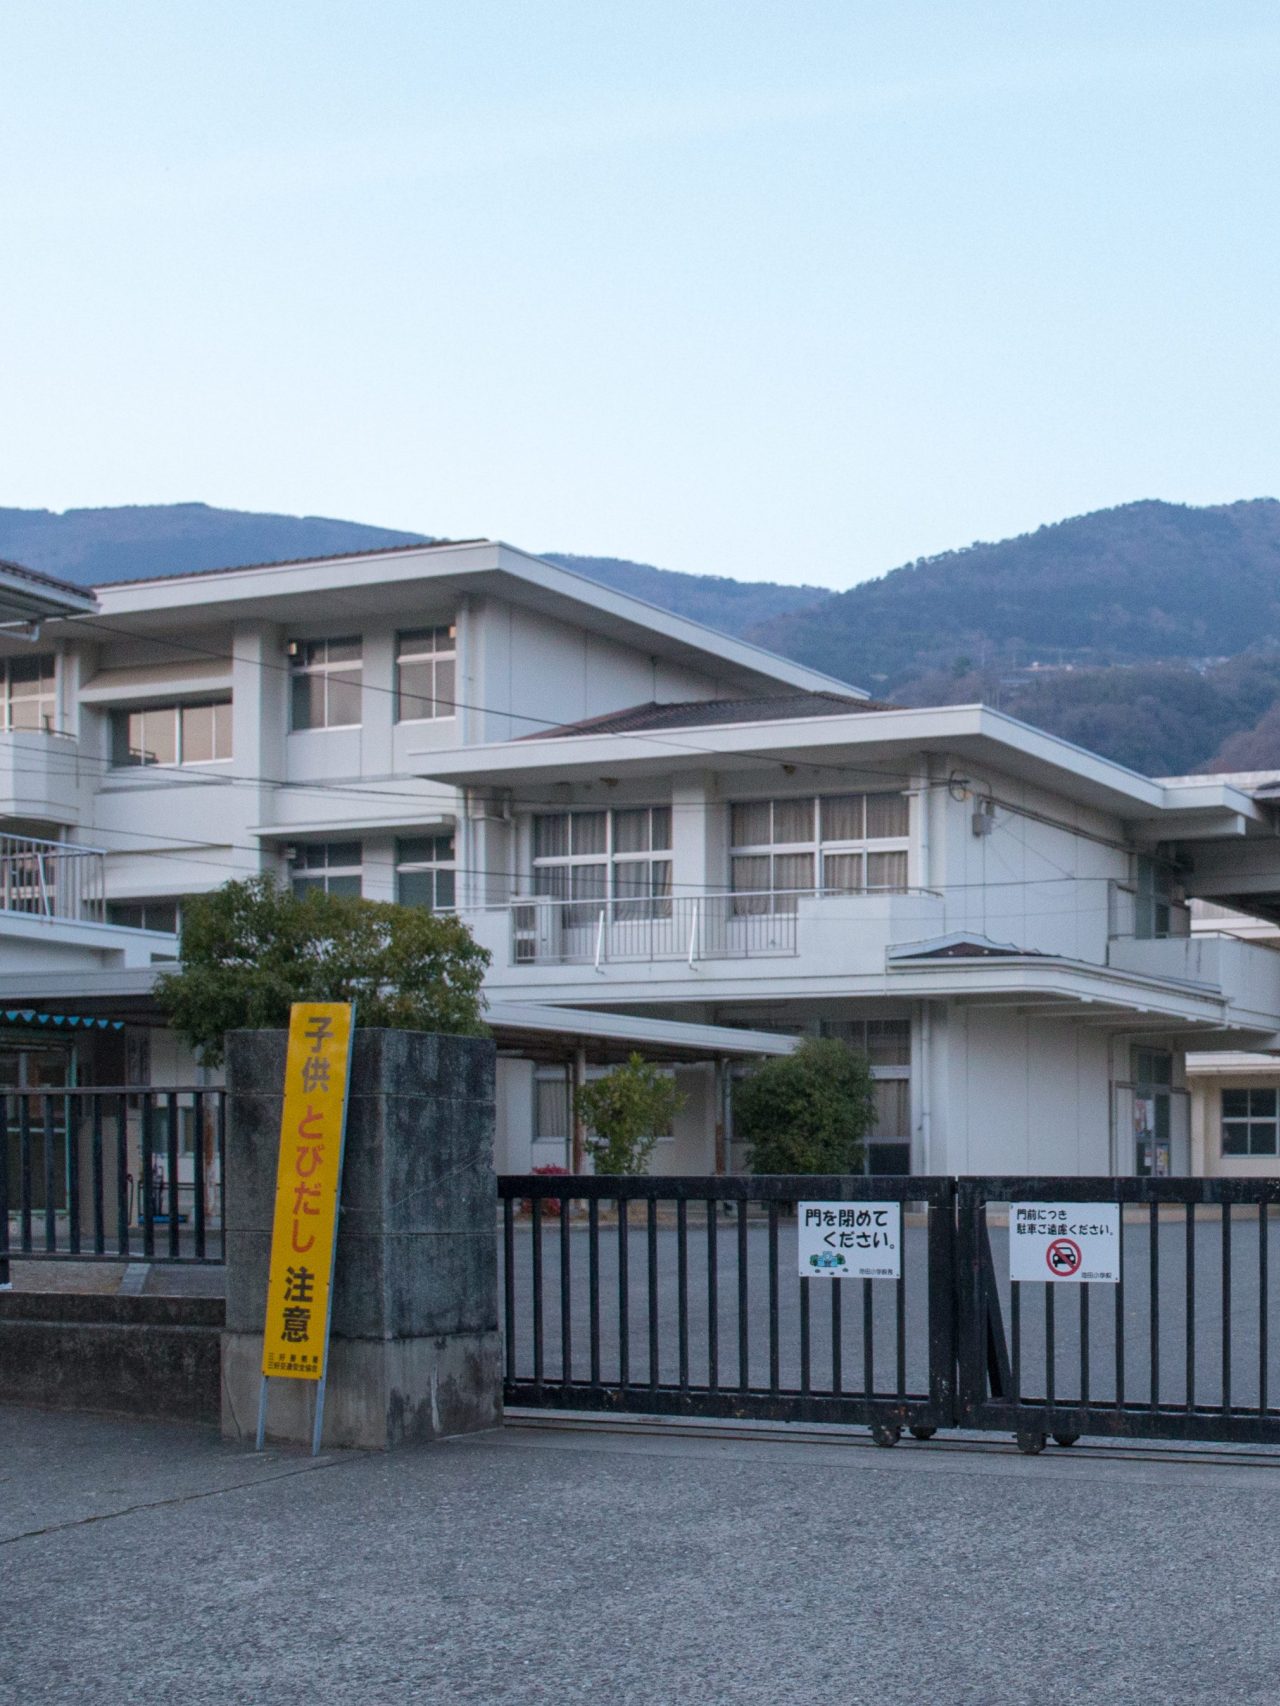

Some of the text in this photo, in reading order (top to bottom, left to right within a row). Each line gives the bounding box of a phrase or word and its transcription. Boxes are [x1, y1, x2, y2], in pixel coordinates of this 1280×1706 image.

[280, 1016, 335, 1343] 子供 とびだし 注意
[804, 1208, 889, 1228] 門を閉めて
[1015, 1208, 1068, 1221] 門前につき
[1015, 1223, 1114, 1236] 駐車ご遠慮ください。
[823, 1230, 895, 1250] ください。
